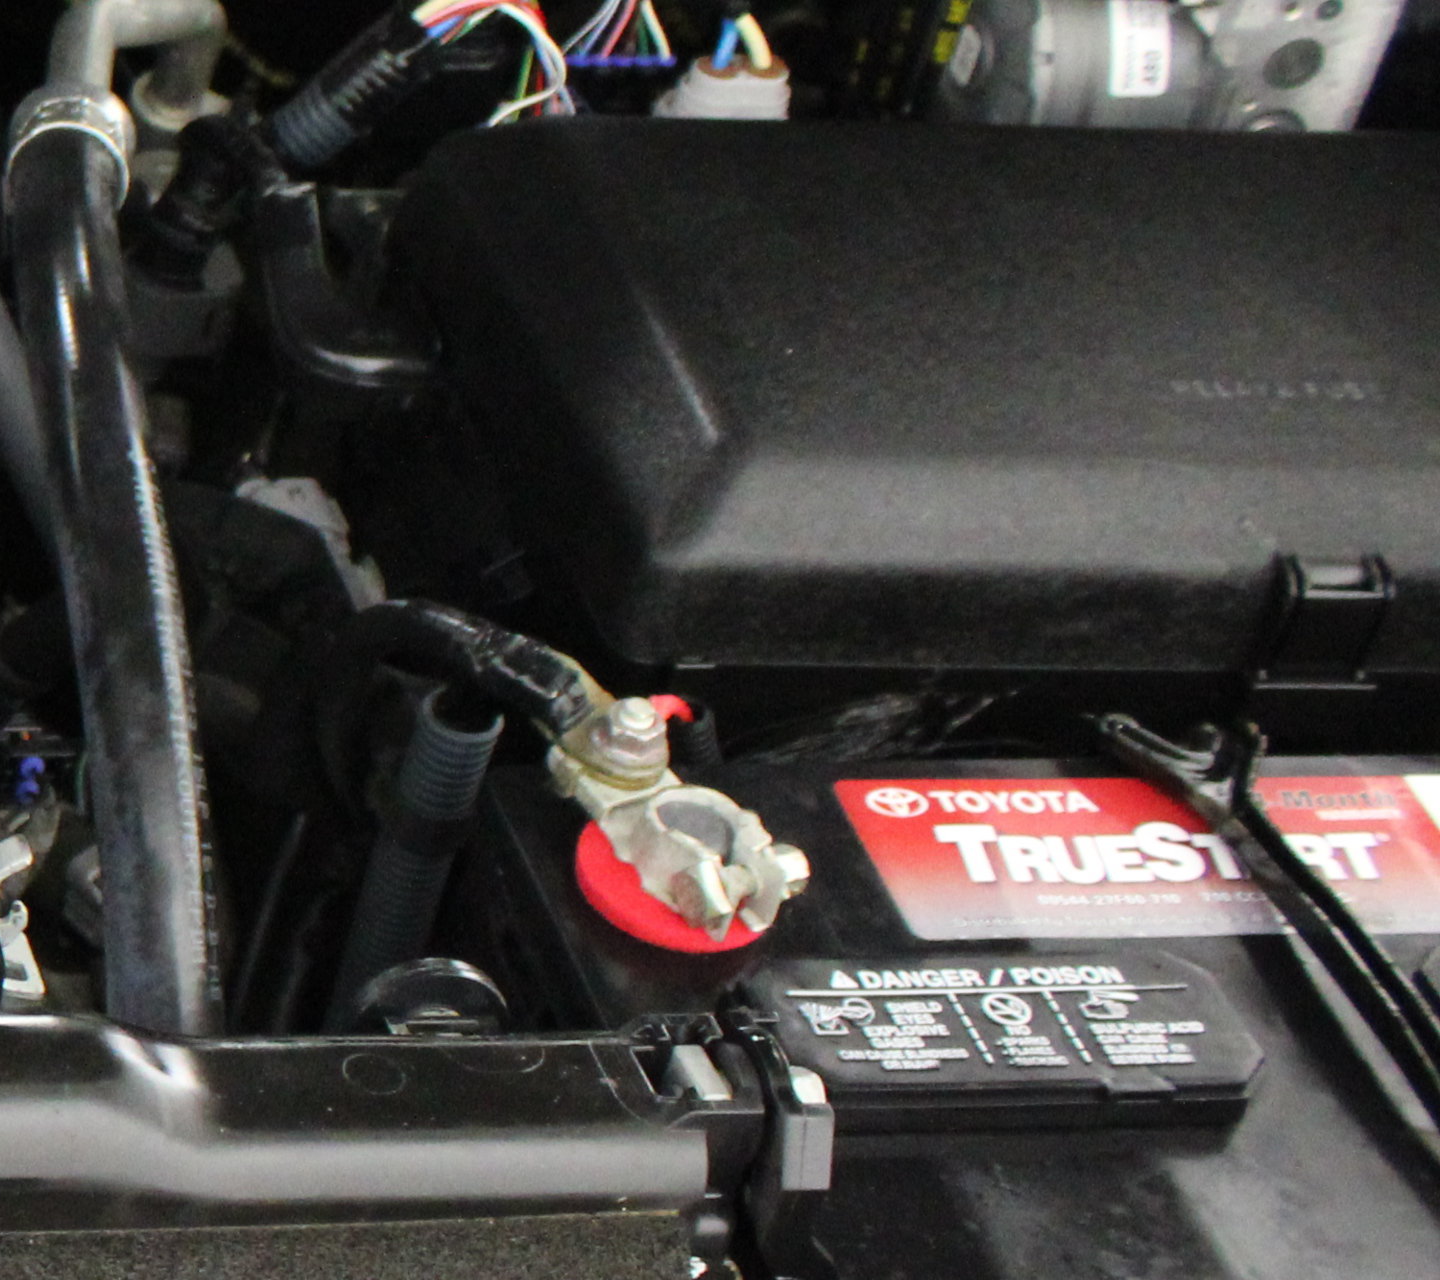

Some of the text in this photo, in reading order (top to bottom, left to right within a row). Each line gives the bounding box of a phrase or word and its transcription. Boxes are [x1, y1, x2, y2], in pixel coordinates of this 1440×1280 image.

[929, 790, 1100, 813] TOYOTA
[933, 821, 1380, 884] TRUESTRT
[857, 969, 986, 988] DANGER
[1008, 966, 1126, 986] POISON
